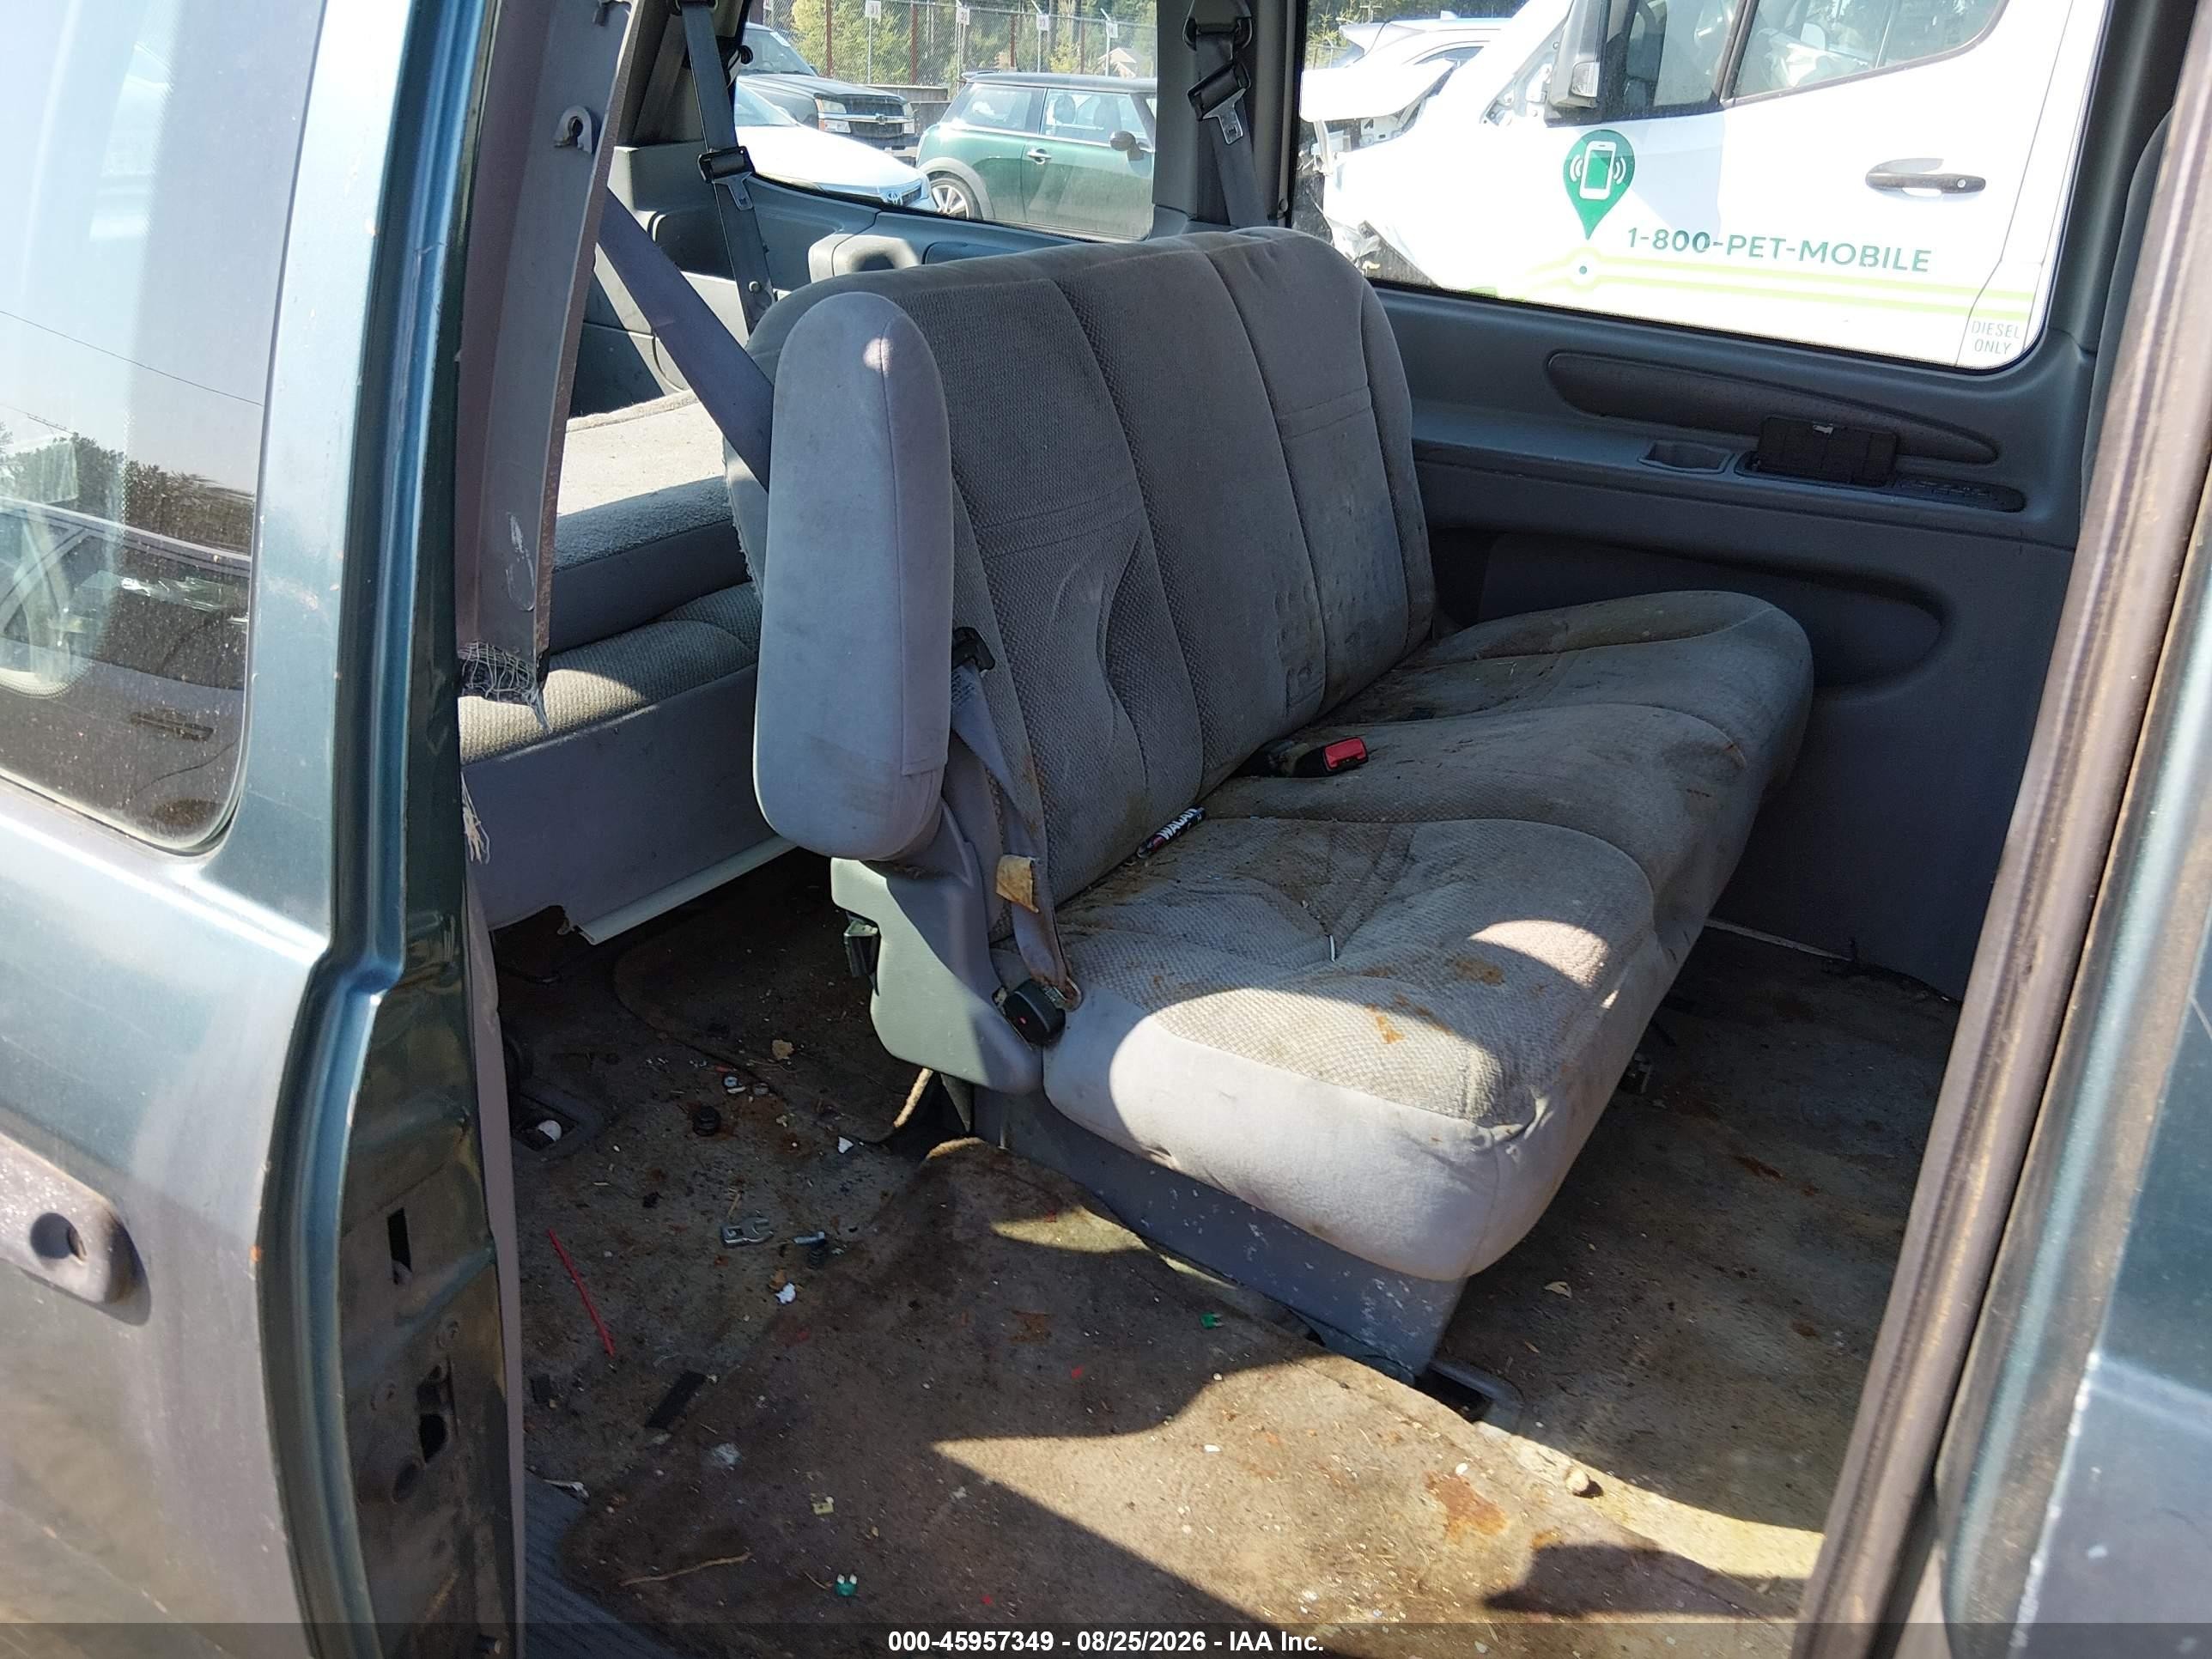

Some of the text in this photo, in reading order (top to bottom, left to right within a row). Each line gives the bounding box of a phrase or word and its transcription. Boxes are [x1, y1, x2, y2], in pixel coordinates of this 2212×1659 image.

[1627, 228, 1931, 272] 1-800-PET-MOBILE
[1972, 320, 2020, 339] DIESEL
[1974, 338, 2012, 355] ONLY
